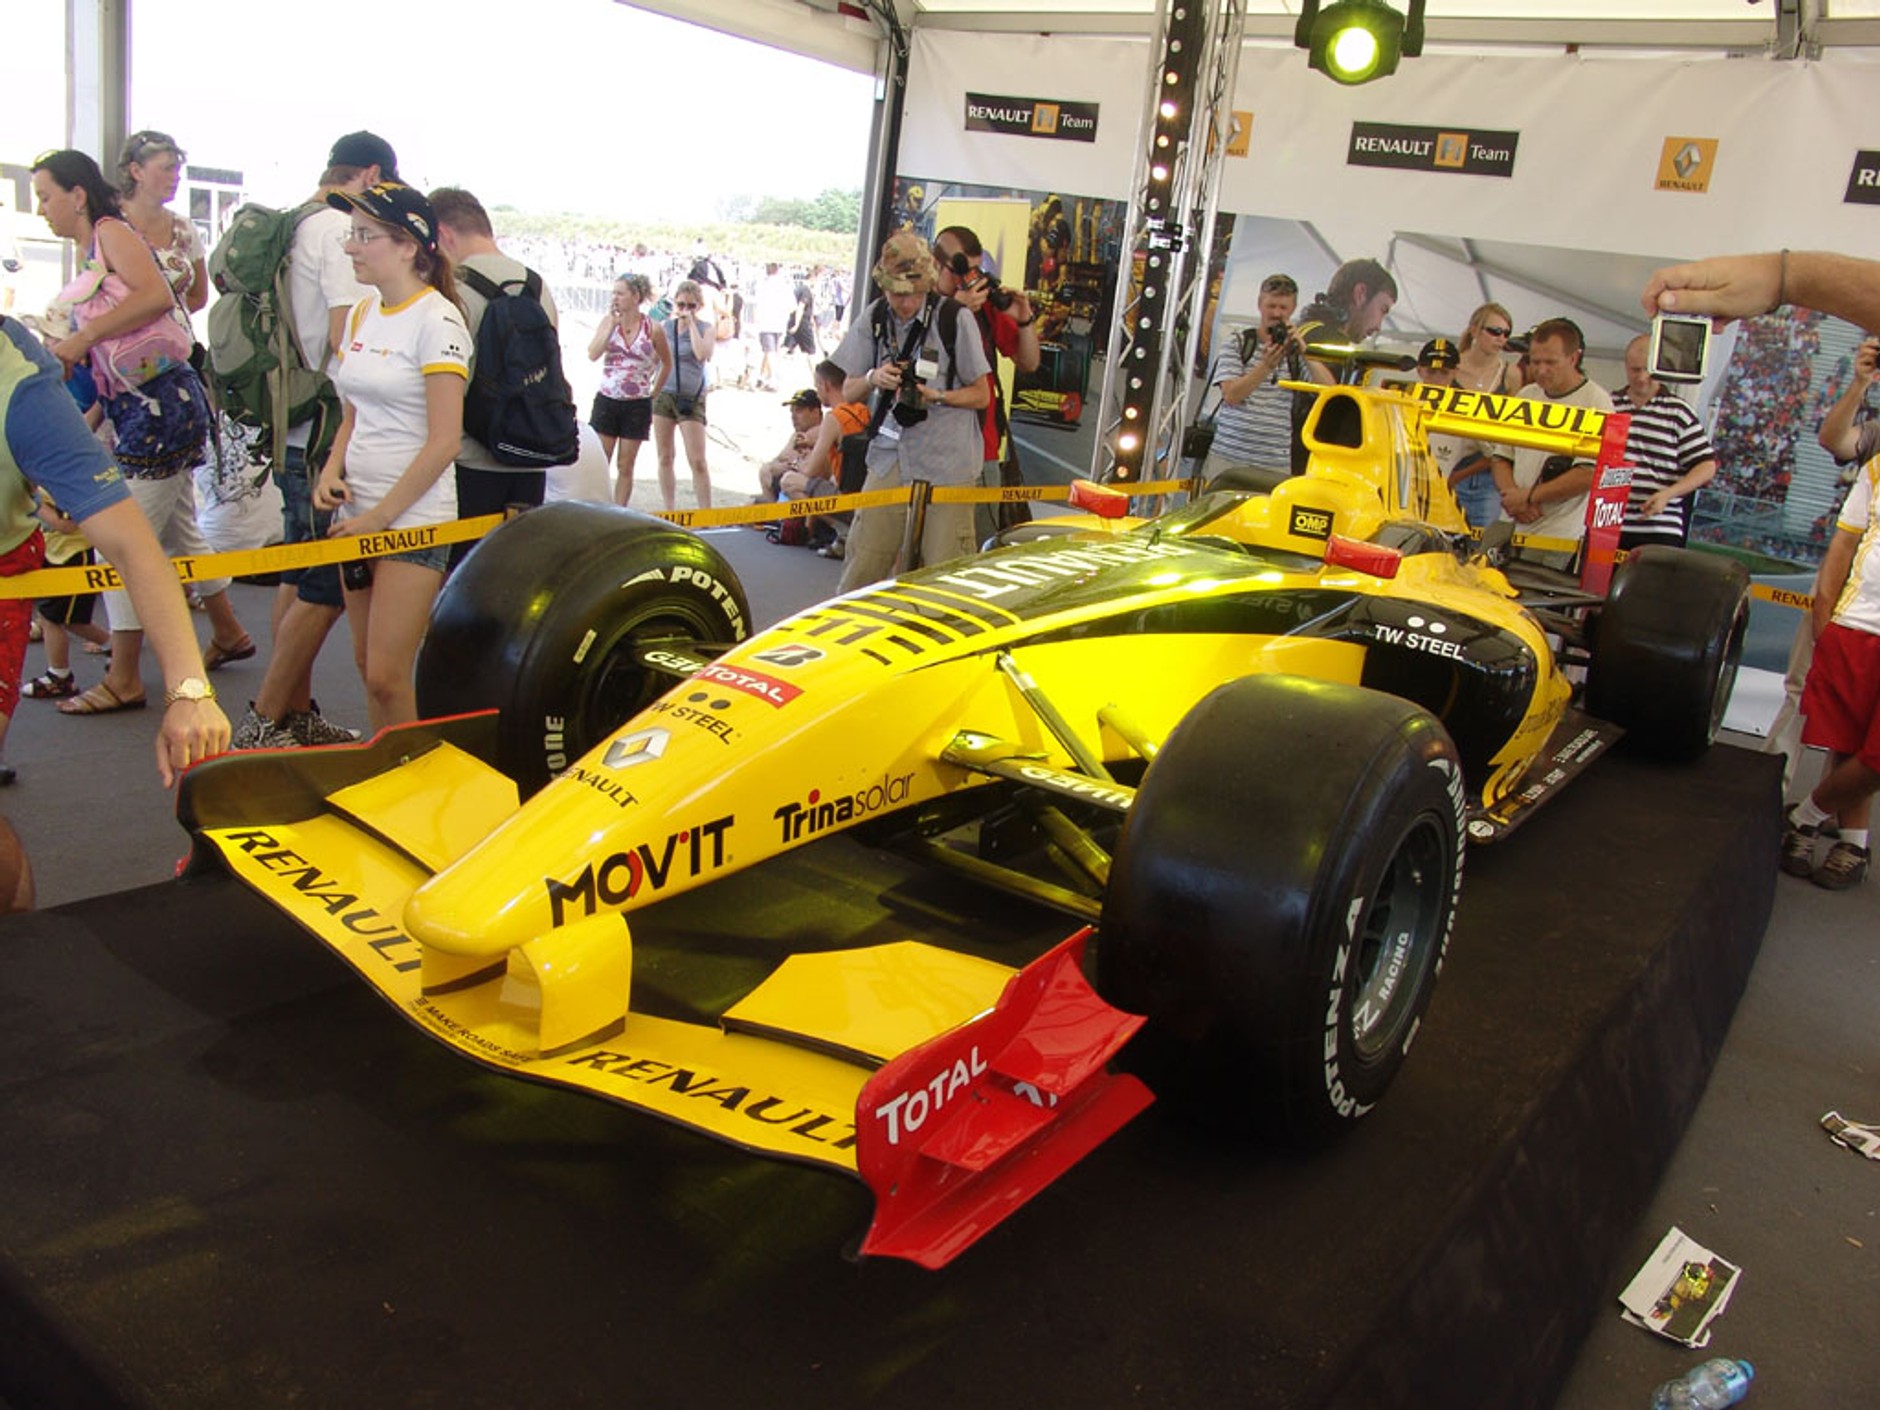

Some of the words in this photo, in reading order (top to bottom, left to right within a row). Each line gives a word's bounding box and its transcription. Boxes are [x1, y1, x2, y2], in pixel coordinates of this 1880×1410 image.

[968, 105, 1032, 124] RENAULT
[1060, 113, 1095, 130] Team
[1355, 136, 1433, 156] RENAULT
[1471, 144, 1511, 162] Team
[789, 498, 838, 516] RENAULT
[1002, 488, 1043, 501] RENAULT
[660, 512, 694, 528] AULT
[1295, 514, 1328, 533] OMP
[1593, 497, 1625, 529] TOTAL
[359, 527, 438, 556] RENAULT
[1374, 623, 1405, 645] TW
[1404, 632, 1464, 662] STEEL
[705, 665, 785, 703] TOTAL
[671, 706, 734, 746] STEEL
[224, 830, 423, 973] RENAULT
[1378, 931, 1410, 1001] RACING
[1324, 896, 1364, 1118] POTENZA
[565, 1050, 857, 1150] RENAULT
[875, 1044, 988, 1145] TOTAL
